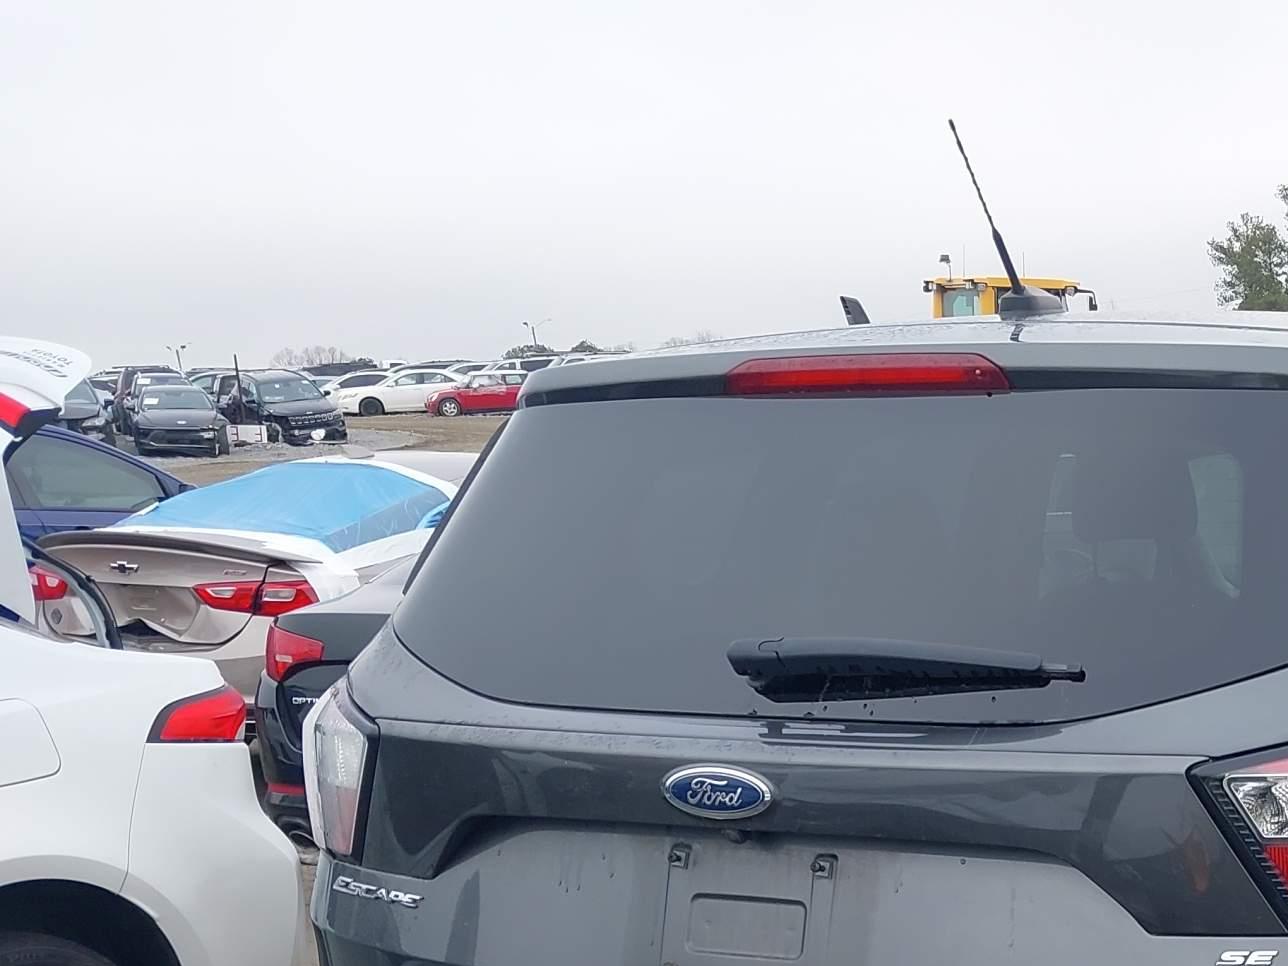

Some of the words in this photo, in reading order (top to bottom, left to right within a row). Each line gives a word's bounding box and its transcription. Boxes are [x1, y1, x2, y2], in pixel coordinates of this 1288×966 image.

[686, 777, 742, 806] Ford
[332, 876, 424, 908] ESCAPE
[1215, 950, 1279, 966] SE
